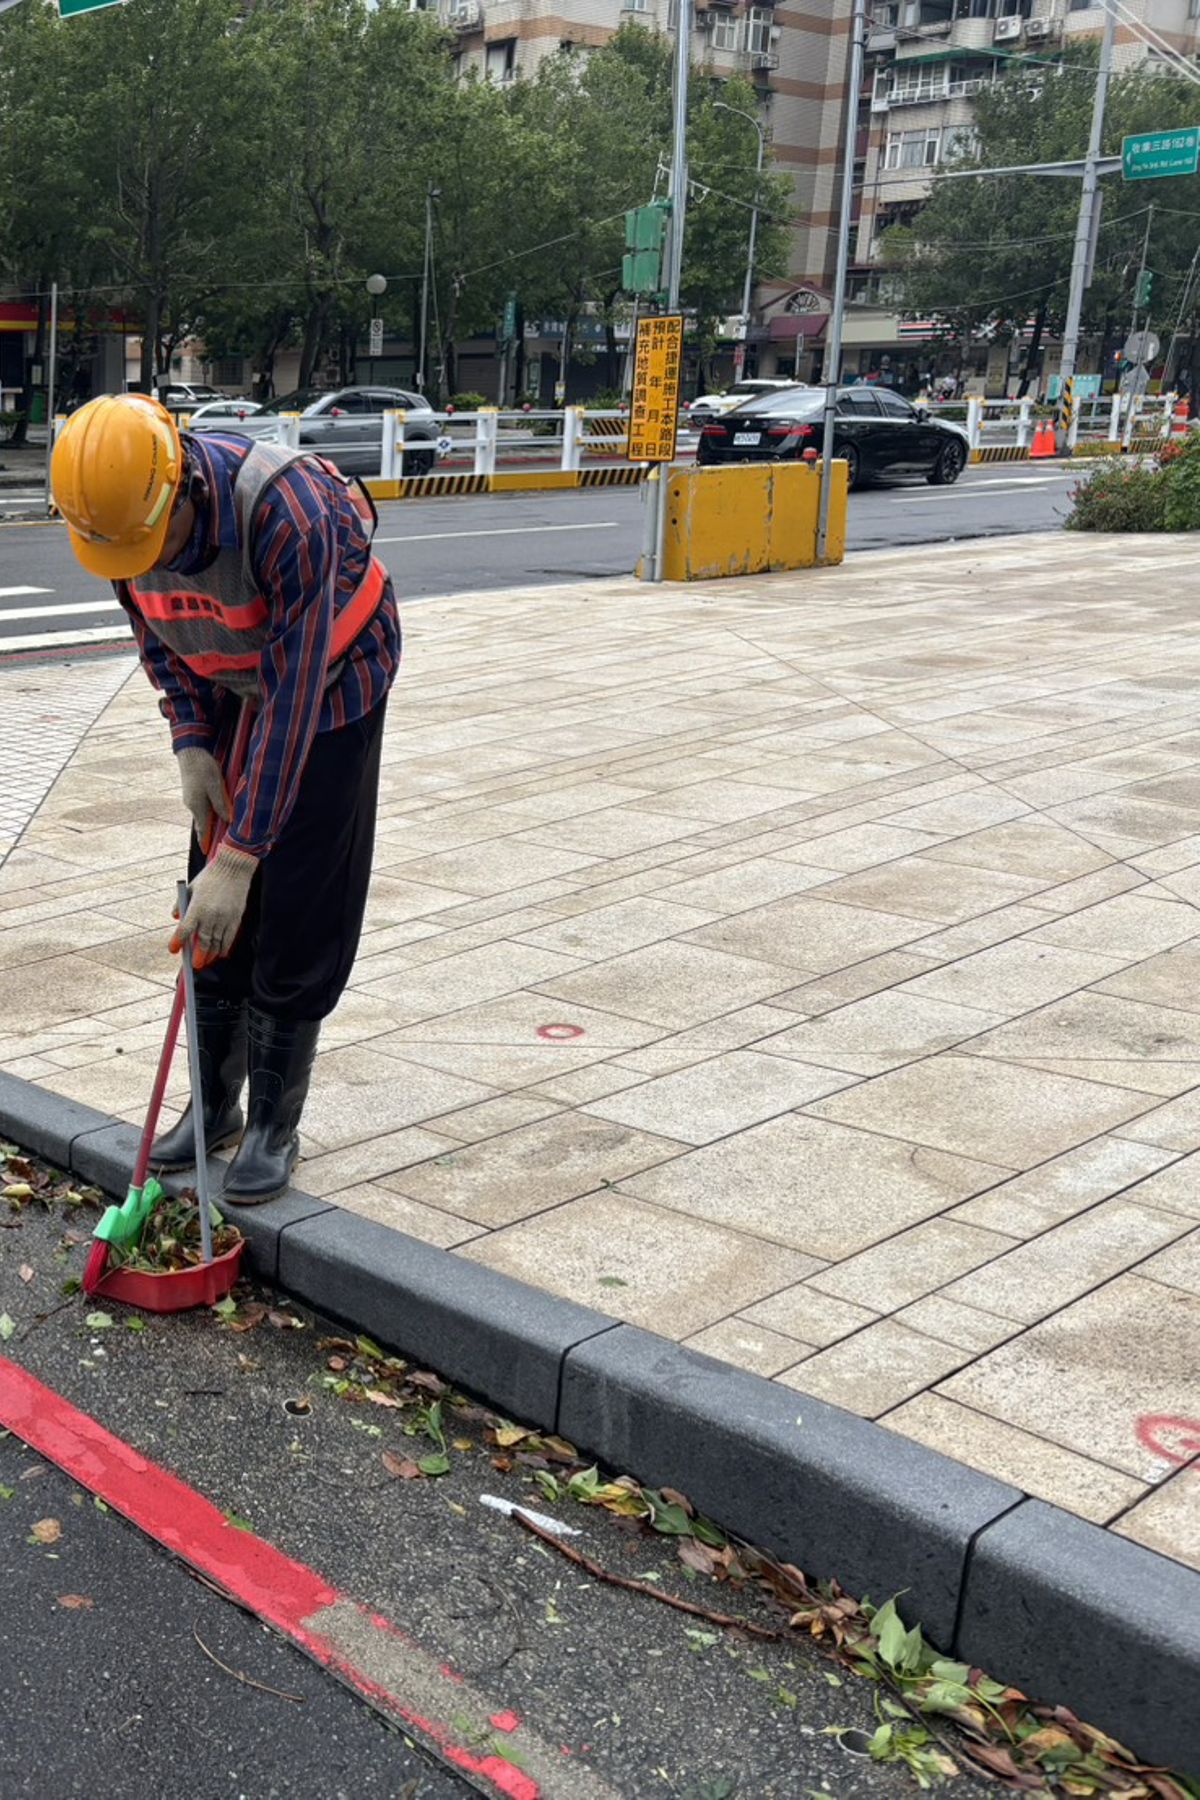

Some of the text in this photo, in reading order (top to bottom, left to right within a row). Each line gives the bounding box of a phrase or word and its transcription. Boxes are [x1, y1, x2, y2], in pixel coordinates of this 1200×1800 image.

[631, 322, 651, 457] 補充地質調查工程
[659, 319, 680, 457] 配合捷運施工本路段
